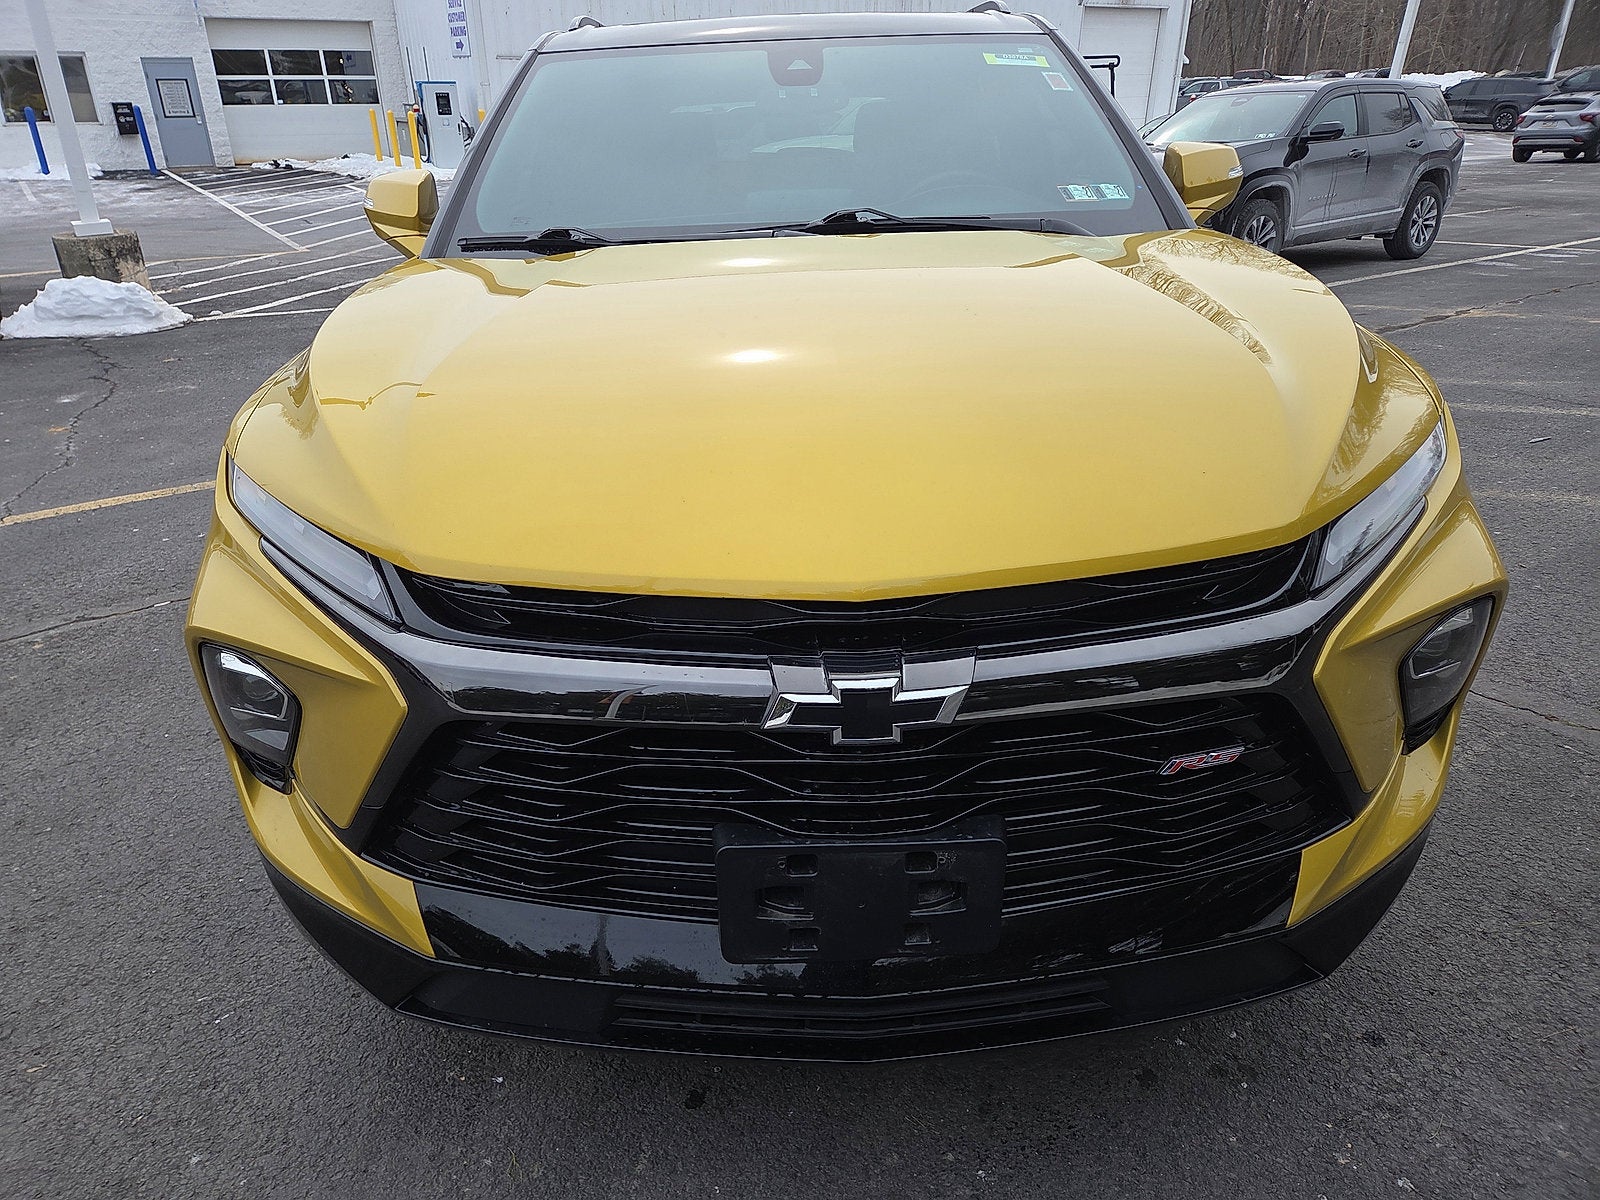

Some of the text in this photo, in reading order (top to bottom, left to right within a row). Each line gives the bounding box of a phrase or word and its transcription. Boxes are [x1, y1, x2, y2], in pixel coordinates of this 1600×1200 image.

[448, 11, 465, 23] CUSTOMER
[450, 26, 466, 37] PARKING
[1160, 747, 1246, 775] RS
